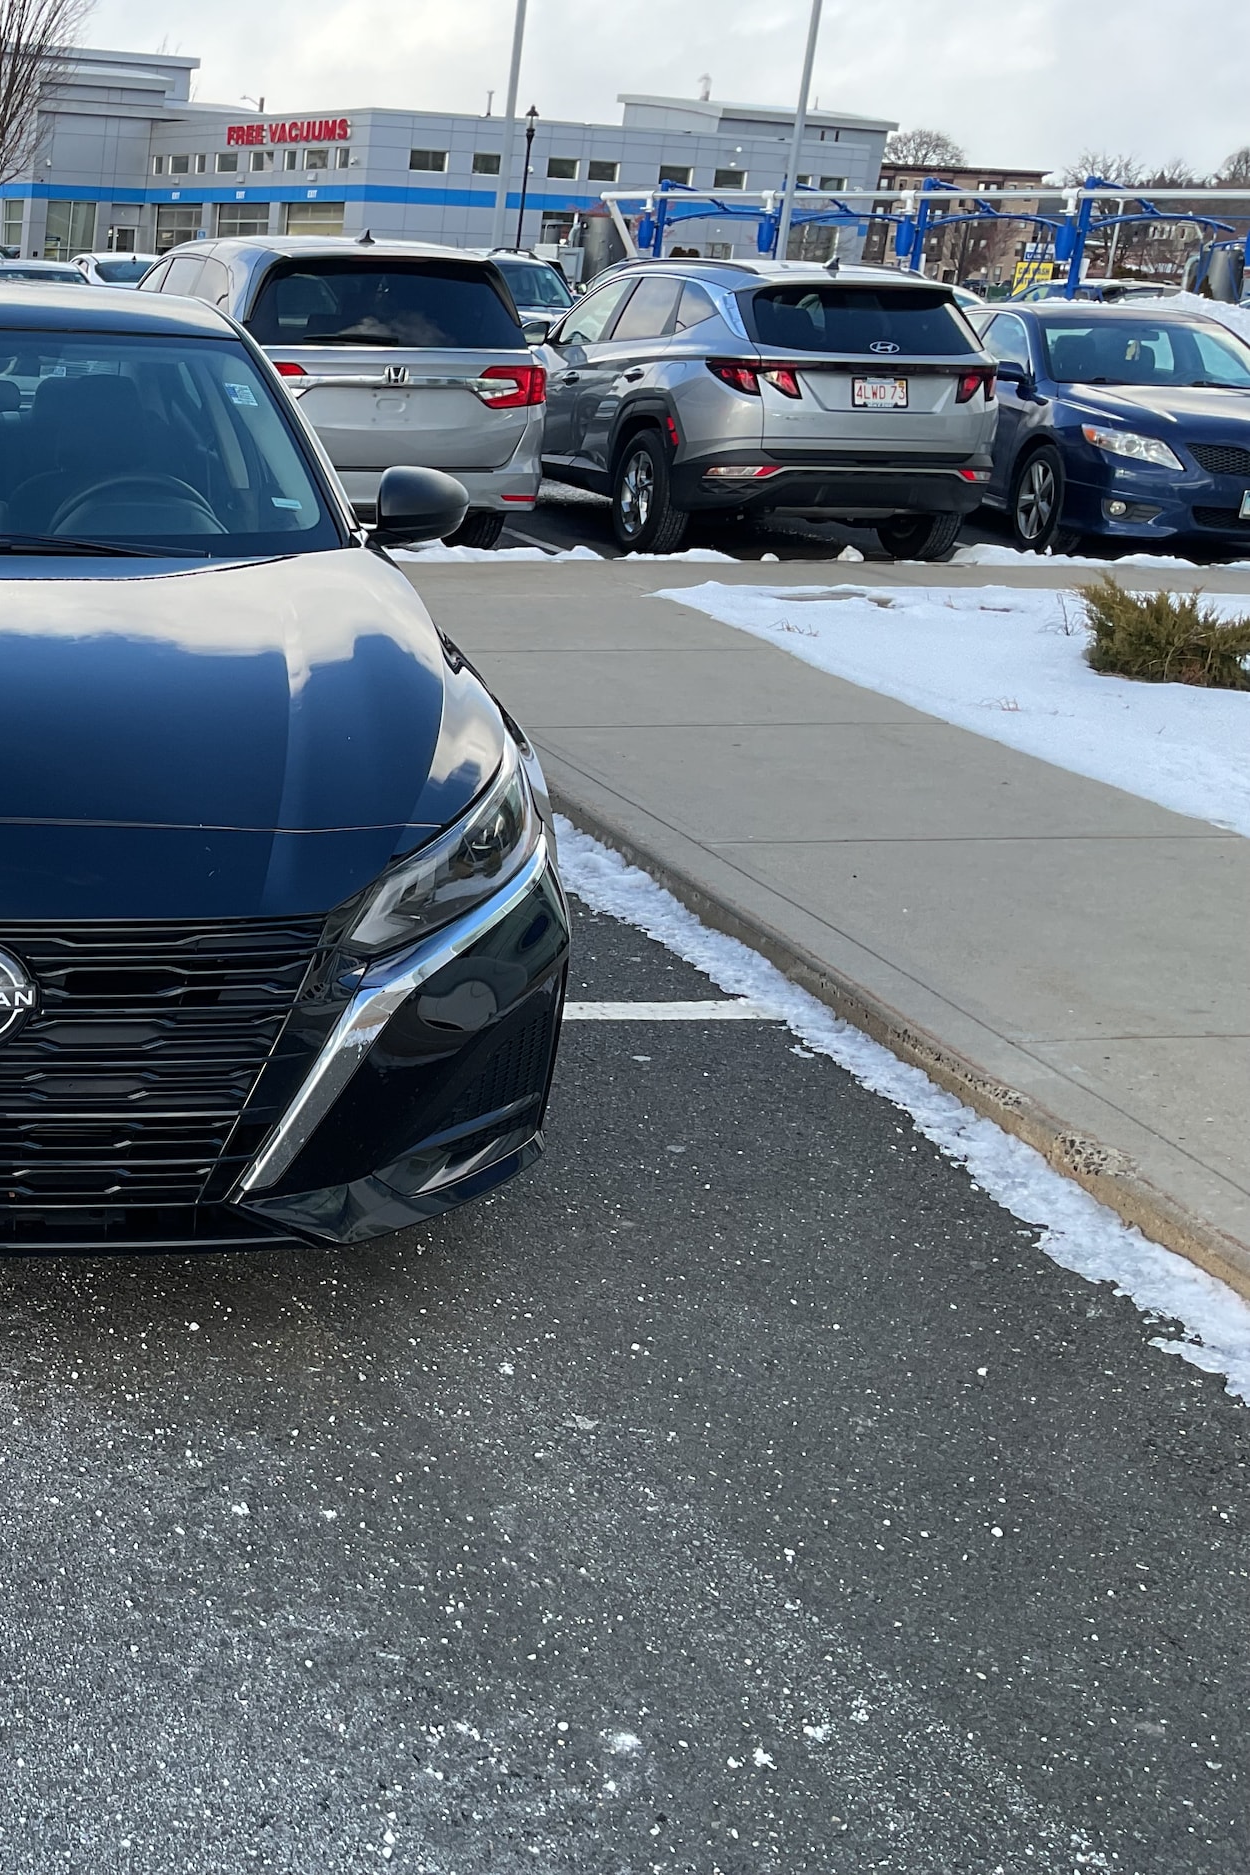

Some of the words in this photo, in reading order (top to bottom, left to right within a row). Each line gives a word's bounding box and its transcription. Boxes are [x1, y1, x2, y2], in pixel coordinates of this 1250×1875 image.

[226, 124, 269, 146] FREE
[269, 118, 352, 144] VACUUMS
[856, 385, 886, 400] 4LWD
[890, 385, 905, 400] 73
